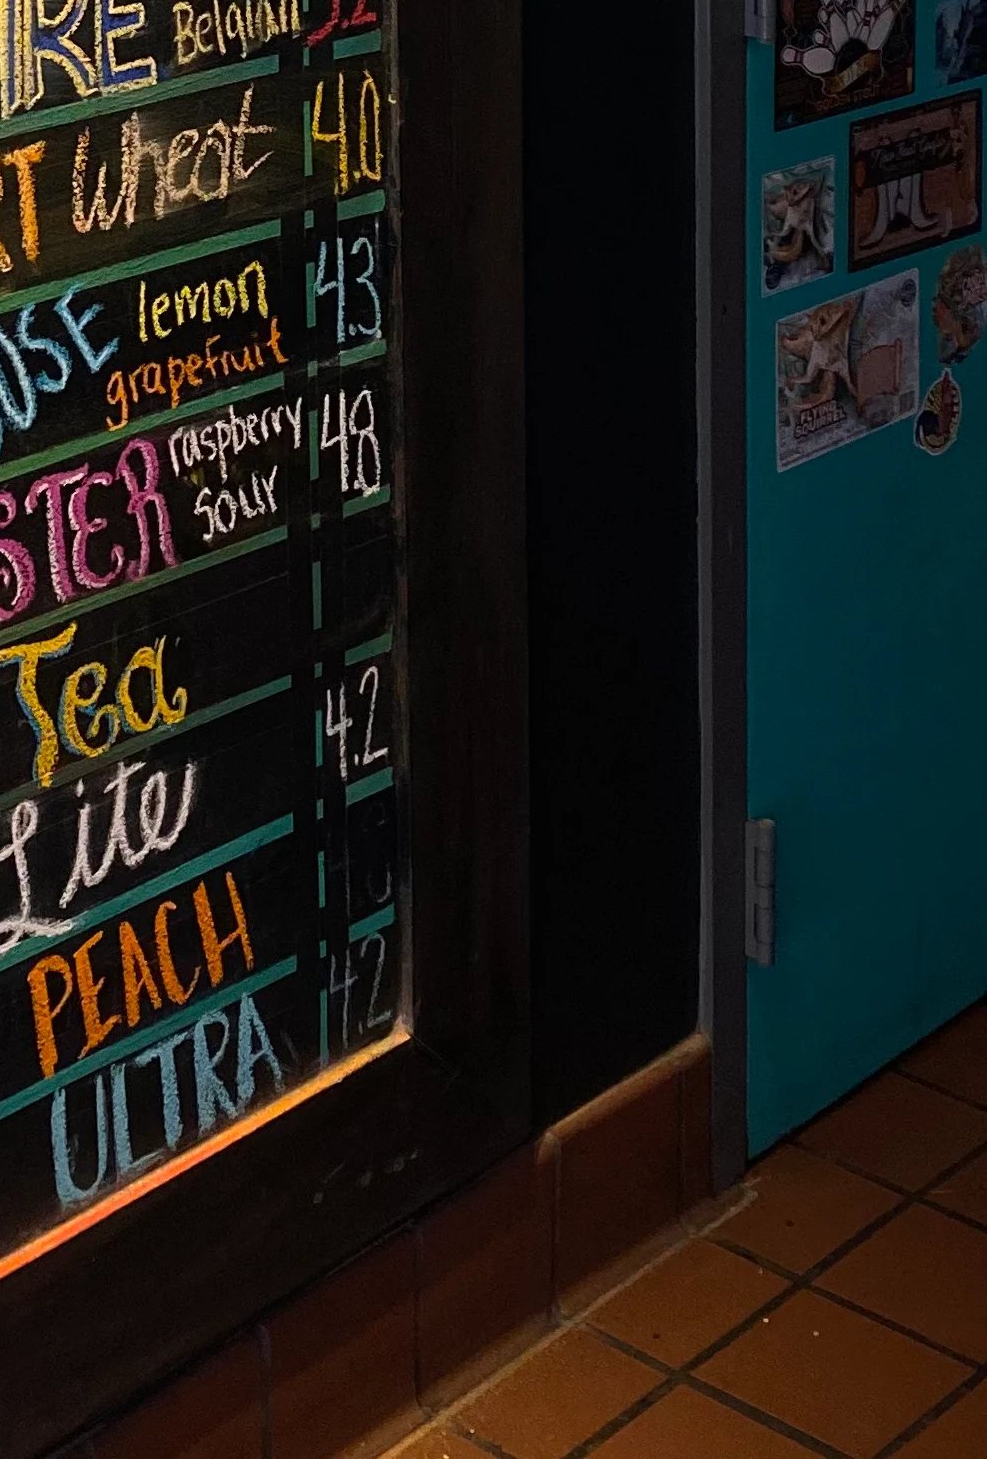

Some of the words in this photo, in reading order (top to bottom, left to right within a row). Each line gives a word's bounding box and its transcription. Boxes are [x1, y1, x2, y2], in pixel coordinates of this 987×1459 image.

[311, 69, 384, 196] 4.0
[138, 260, 269, 343] lemon
[313, 237, 383, 345] 4.3
[106, 315, 289, 432] grapefruit
[168, 396, 302, 484] raspberry
[320, 388, 382, 498] 4.8
[325, 665, 390, 783] 4.2
[26, 871, 255, 1080] PEACH
[51, 991, 286, 1212] ULTRA
